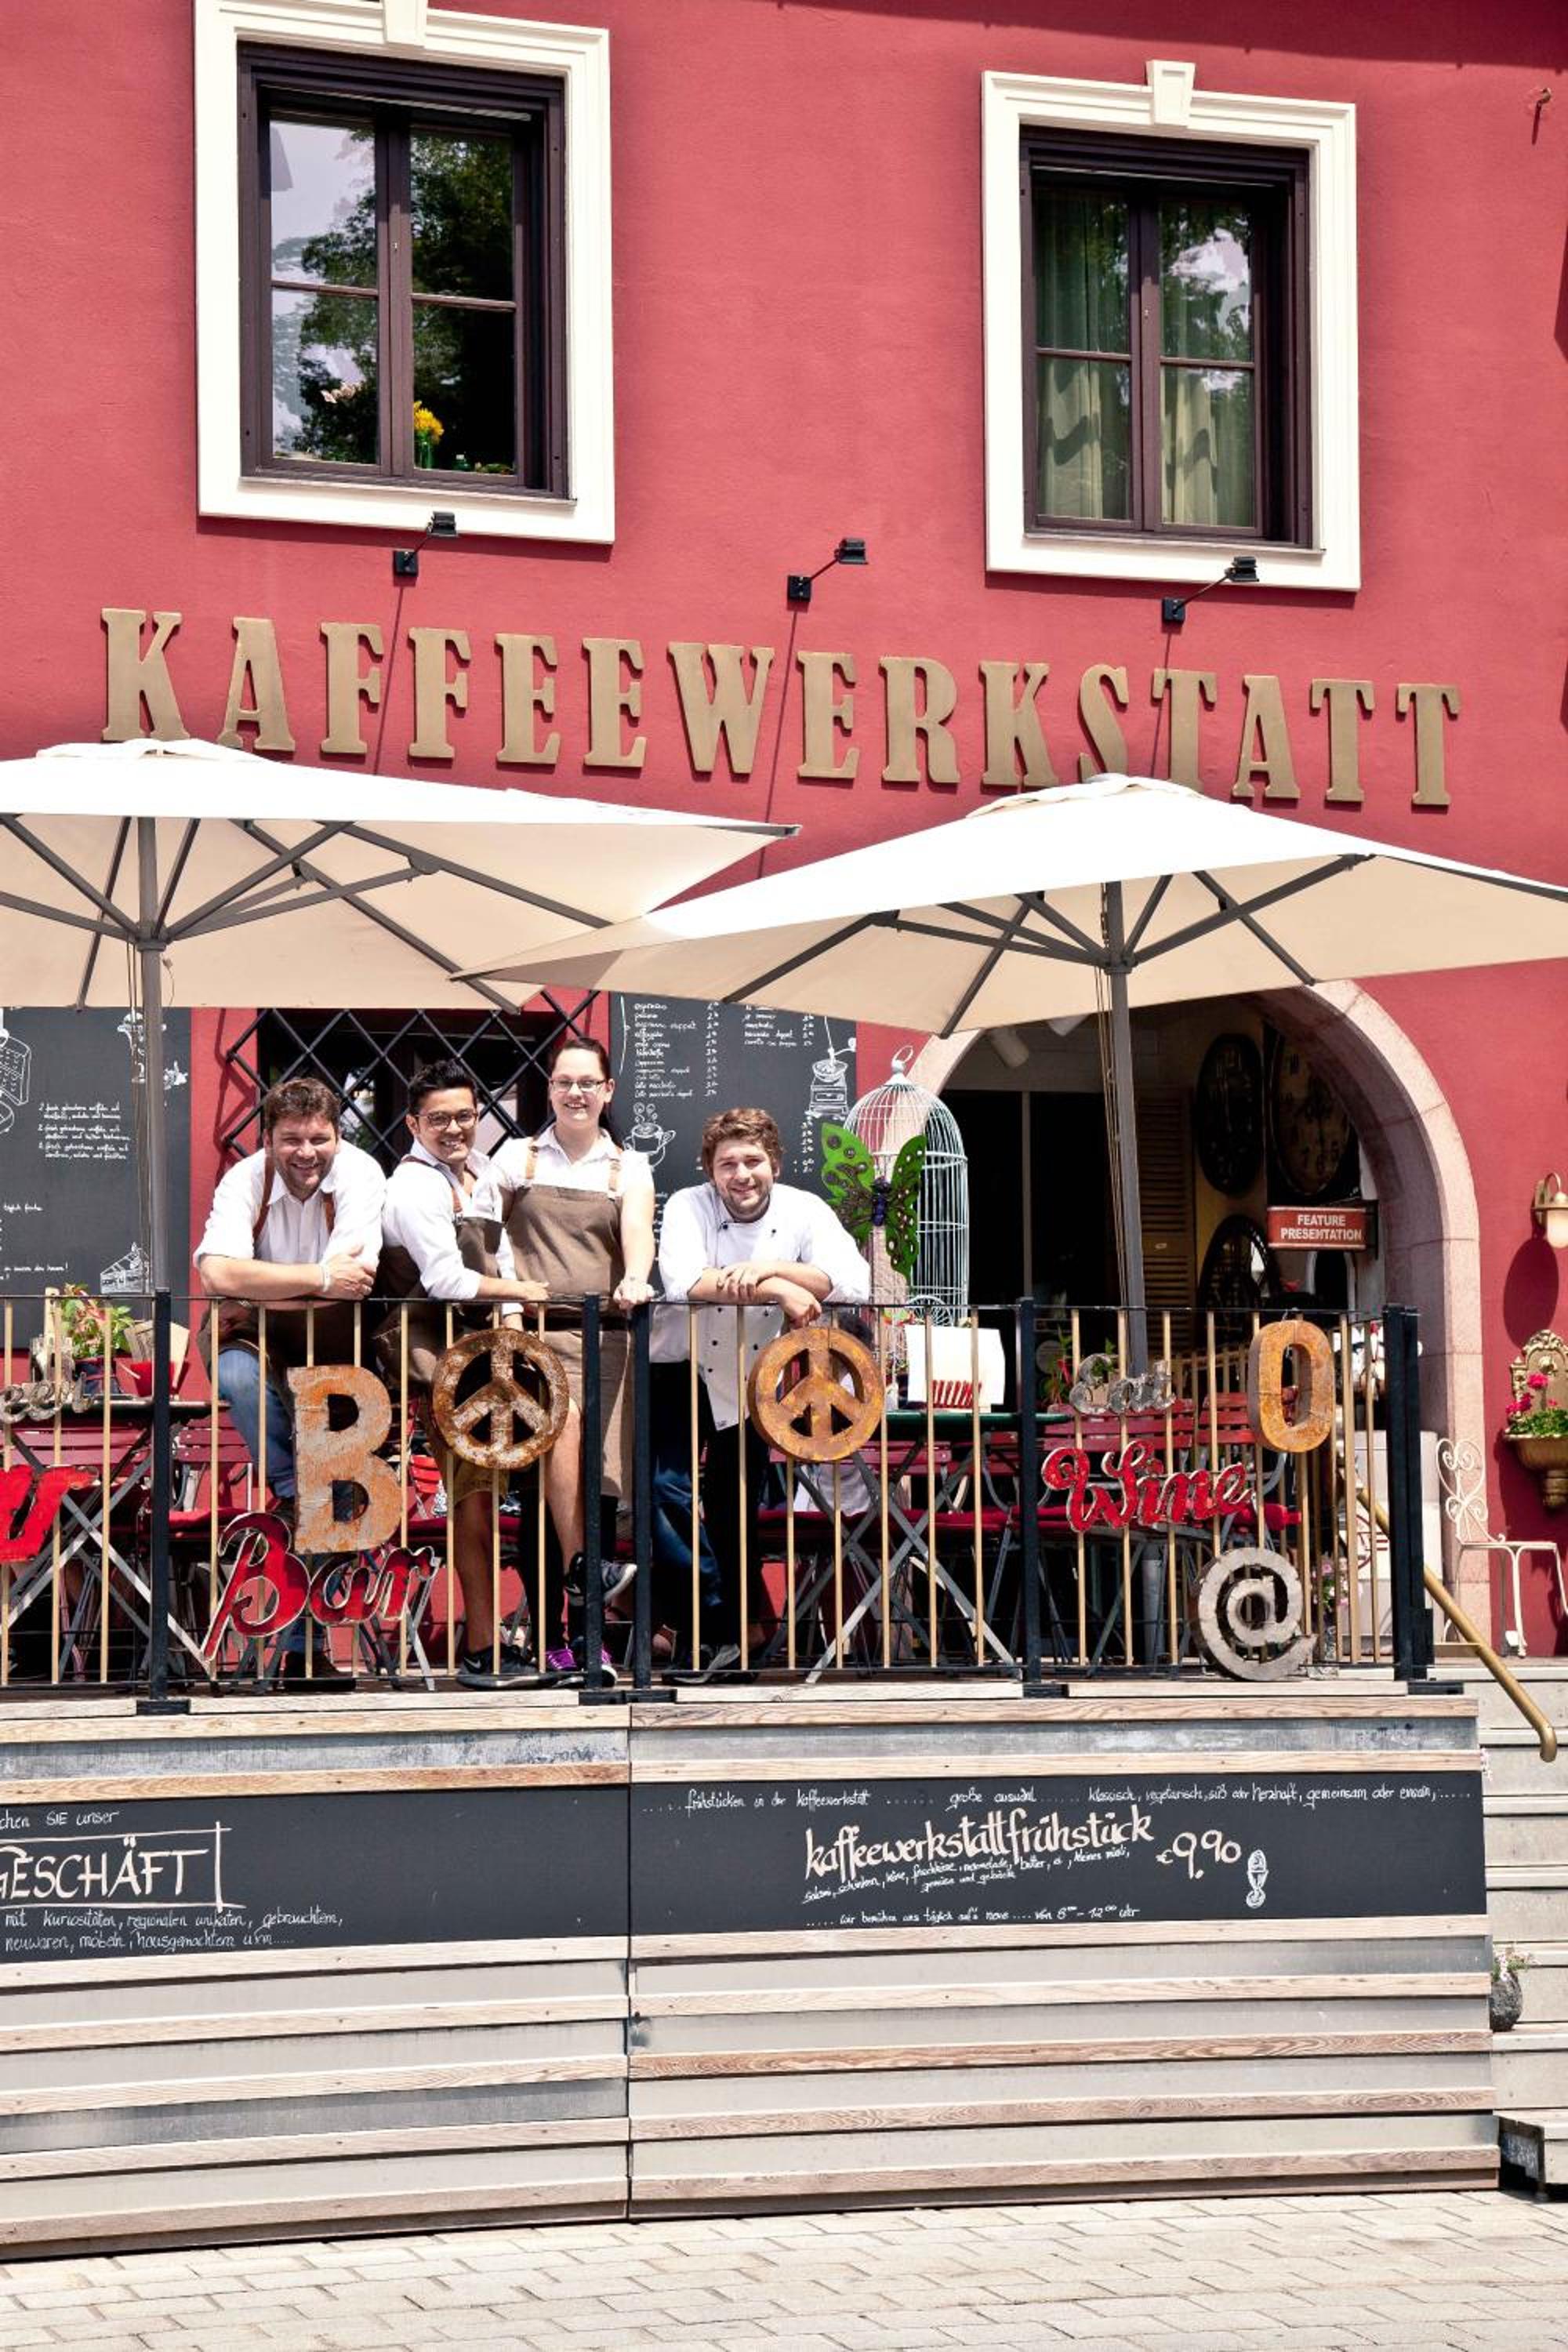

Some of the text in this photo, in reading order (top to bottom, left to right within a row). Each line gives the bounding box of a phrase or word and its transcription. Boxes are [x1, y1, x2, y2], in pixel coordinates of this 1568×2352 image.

[101, 608, 1459, 805] KAFFEEWERKSTATT
[1280, 1227, 1362, 1240] PRESENTATION
[1298, 1214, 1346, 1226] FEATURE
[288, 1366, 403, 1555] B
[1041, 1440, 1256, 1533] Wine
[201, 1512, 442, 1661] Bar
[1191, 1547, 1317, 1681] @
[45, 1811, 68, 1825] SIE
[76, 1811, 119, 1826] unser
[1371, 1783, 1394, 1799] oder
[804, 1805, 1154, 1883] kaffeewerkstattfrühstück
[5, 1907, 27, 1927] mit
